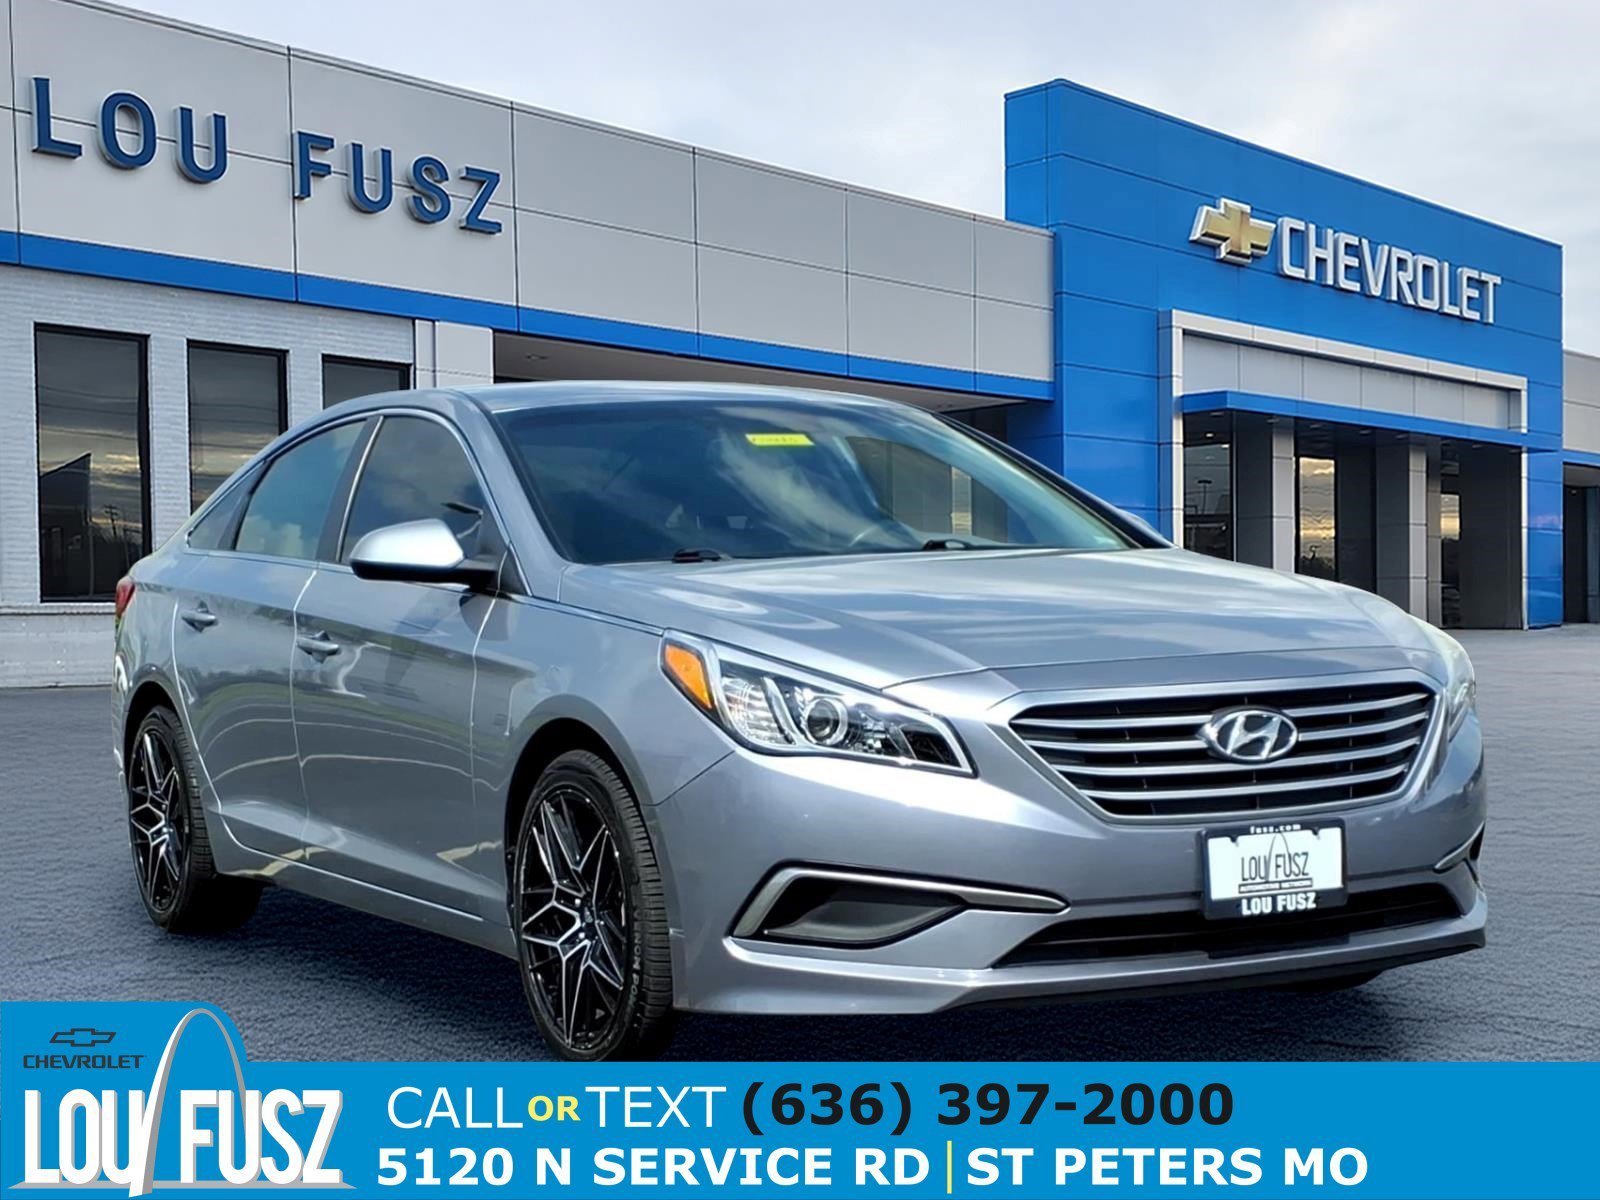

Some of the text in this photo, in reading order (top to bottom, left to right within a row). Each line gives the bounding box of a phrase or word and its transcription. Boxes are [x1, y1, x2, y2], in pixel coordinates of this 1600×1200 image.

[31, 76, 503, 235] LOU FUSZ
[1277, 216, 1501, 324] CHEVROLET
[1250, 823, 1301, 834] fusz.com
[1241, 852, 1309, 881] LOU FUSZ
[1241, 892, 1317, 916] LOU FUSZ
